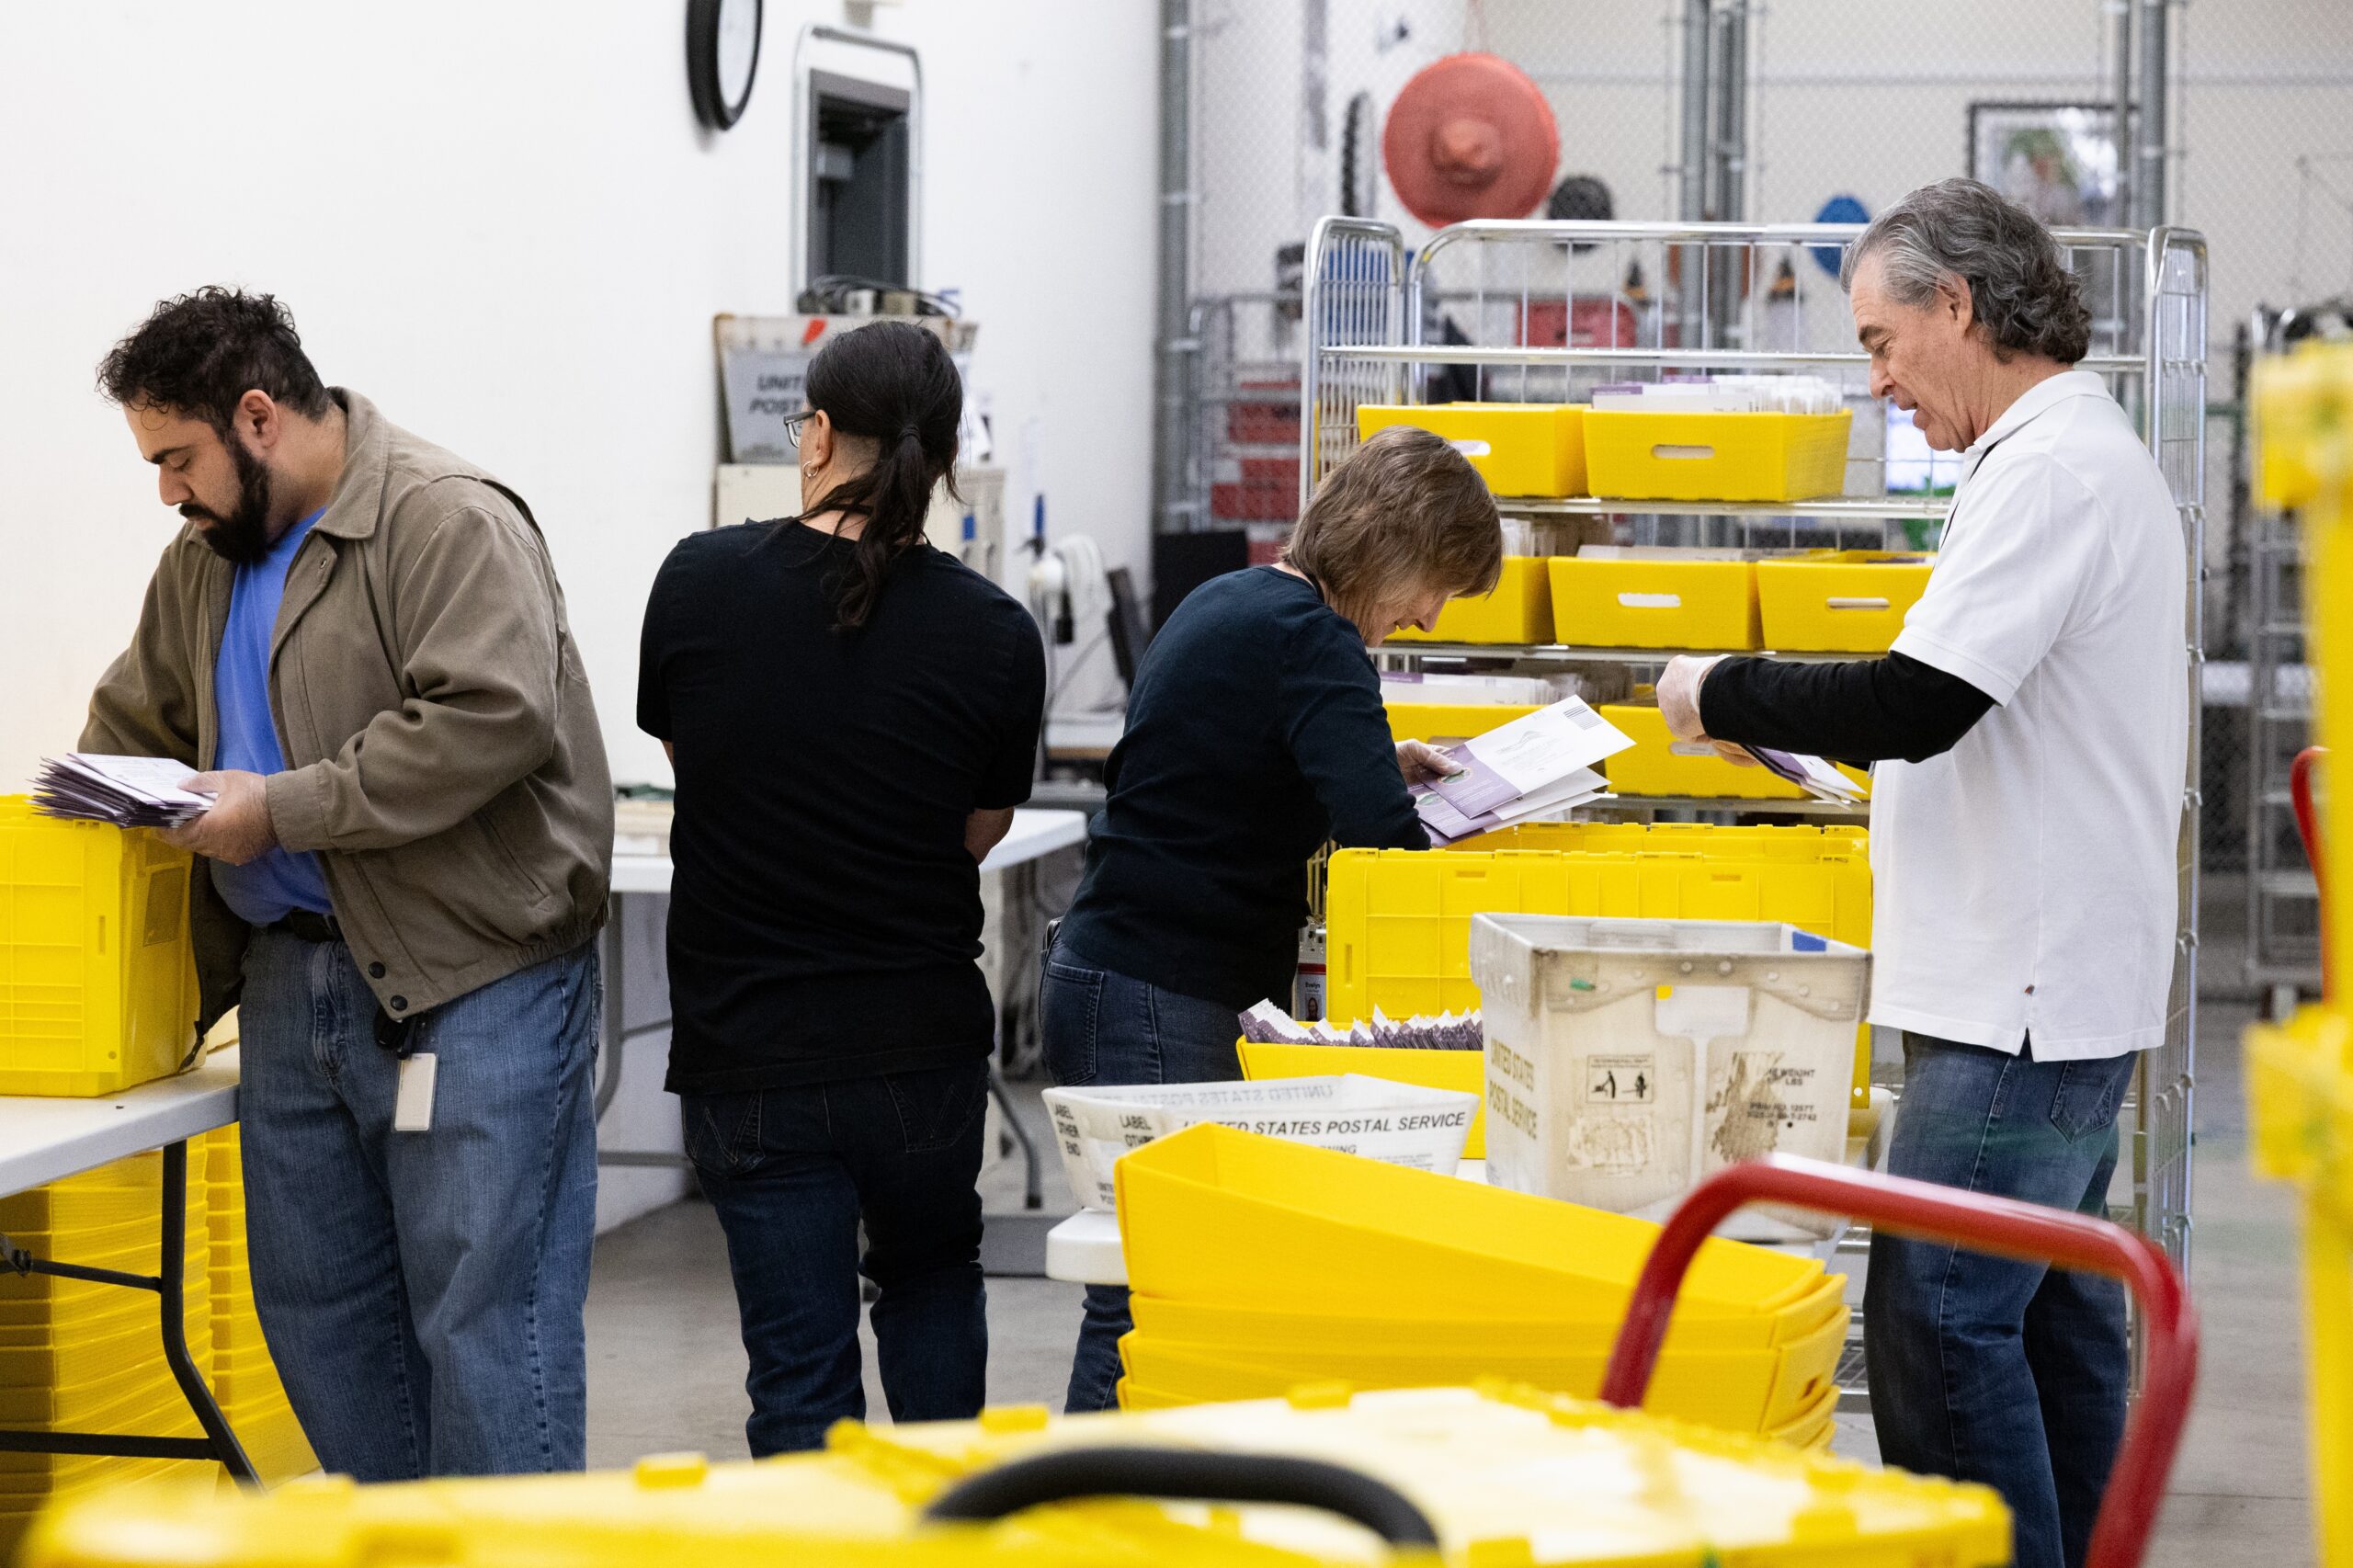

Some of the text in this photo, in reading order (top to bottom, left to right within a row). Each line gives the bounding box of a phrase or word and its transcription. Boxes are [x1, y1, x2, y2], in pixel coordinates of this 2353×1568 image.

[756, 374, 803, 392] UNIT
[748, 397, 801, 415] POST
[1254, 1121, 1322, 1135] STATES
[1326, 1118, 1392, 1134] POSTAL
[1398, 1111, 1466, 1131] SERVICE
